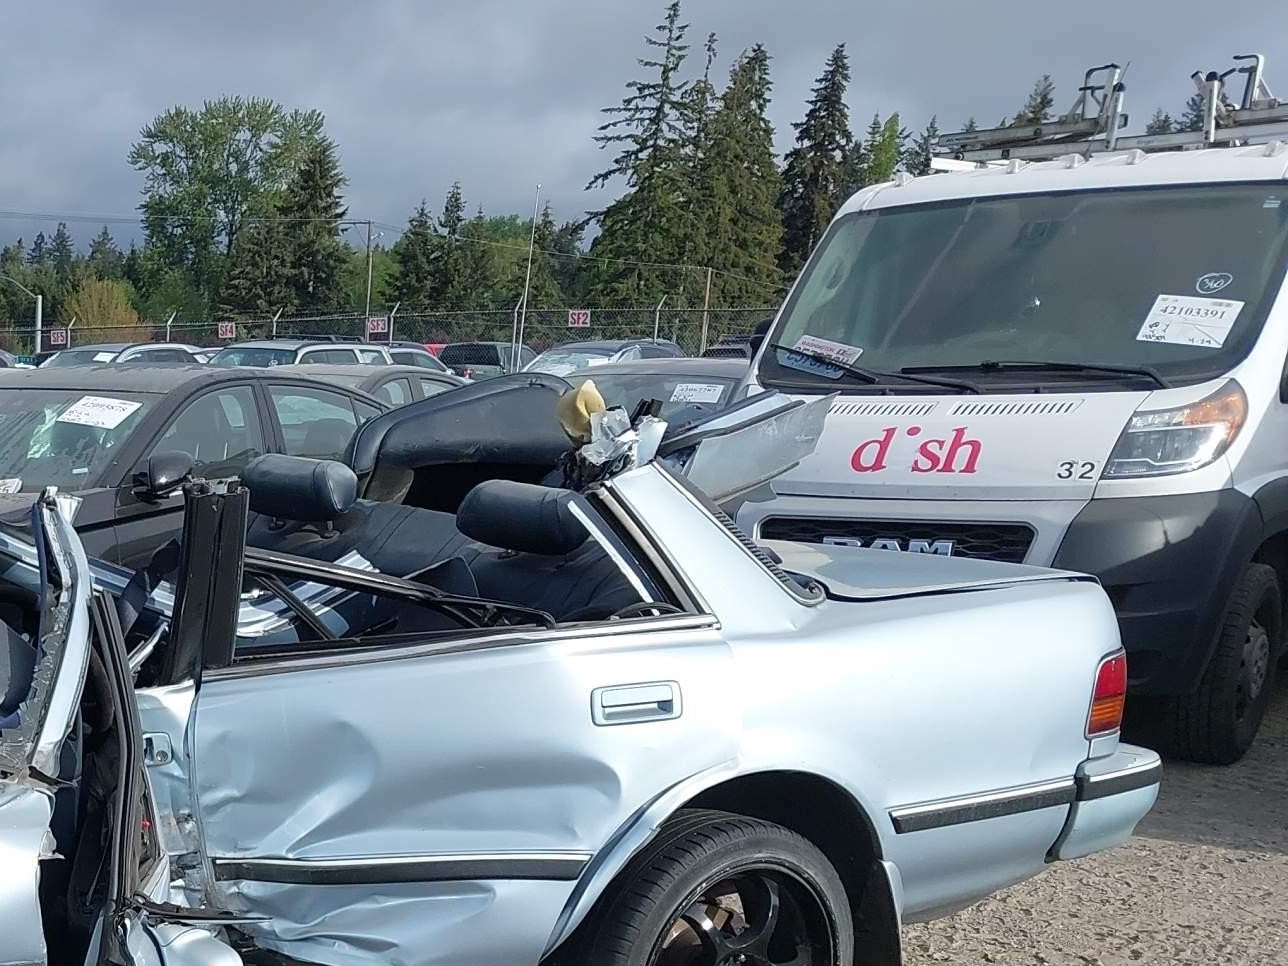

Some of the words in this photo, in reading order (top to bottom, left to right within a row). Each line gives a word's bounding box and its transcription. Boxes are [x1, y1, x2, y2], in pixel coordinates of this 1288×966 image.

[569, 312, 590, 326] SF2
[1159, 304, 1226, 320] 42103391
[219, 324, 235, 337] SF4
[369, 319, 387, 332] SF3
[51, 332, 66, 344] SF5
[850, 425, 983, 474] dsh
[1056, 460, 1097, 480] 32
